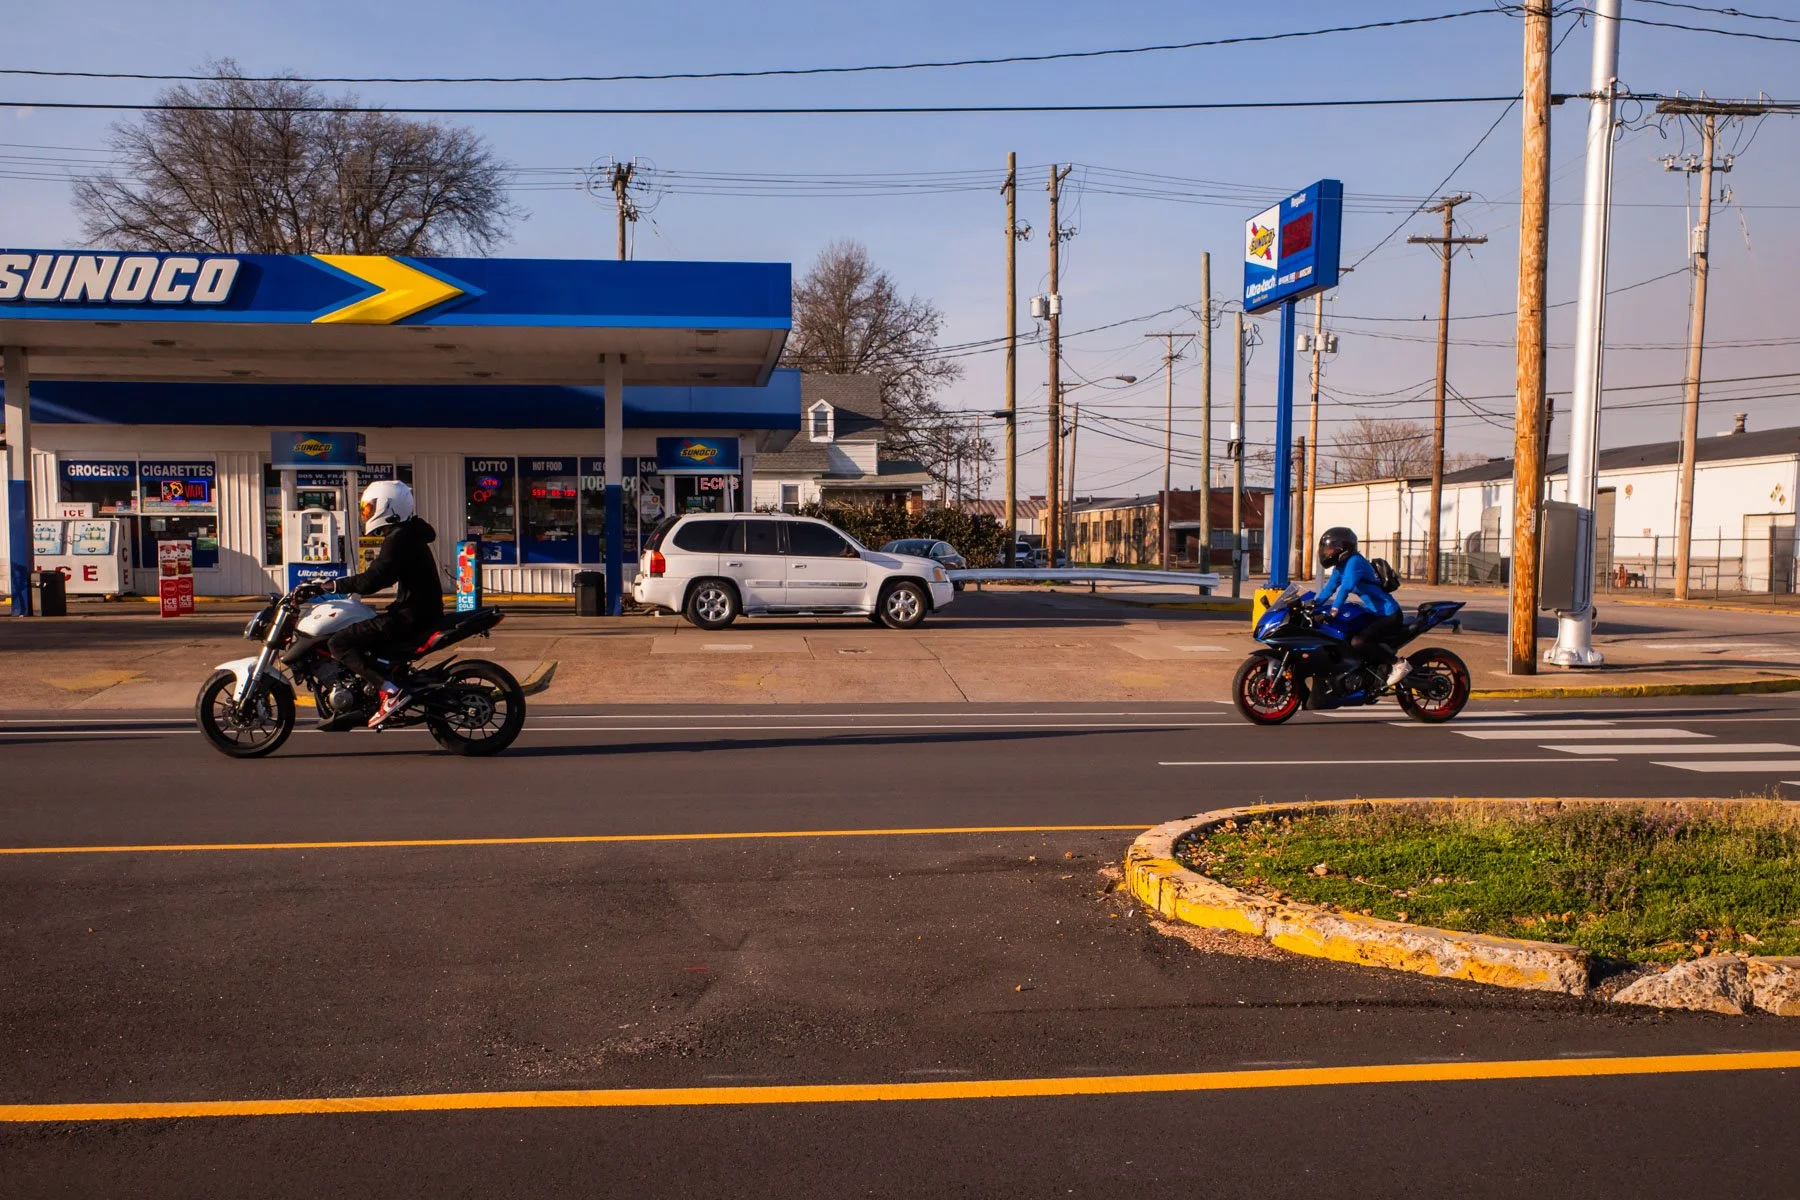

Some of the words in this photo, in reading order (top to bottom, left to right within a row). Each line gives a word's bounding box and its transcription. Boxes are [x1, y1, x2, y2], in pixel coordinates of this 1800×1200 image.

[0, 254, 240, 302] SUNOCO
[295, 443, 332, 452] SUNOCO
[682, 449, 716, 457] SUNOCO
[67, 464, 129, 477] GROCERYS
[141, 465, 214, 477] CIGARETTES
[366, 465, 393, 474] MART
[472, 461, 507, 472] LOTTO
[532, 461, 545, 471] HOT
[546, 461, 563, 471] FOOD
[581, 476, 638, 491] TOBCO
[458, 596, 474, 604] ICE
